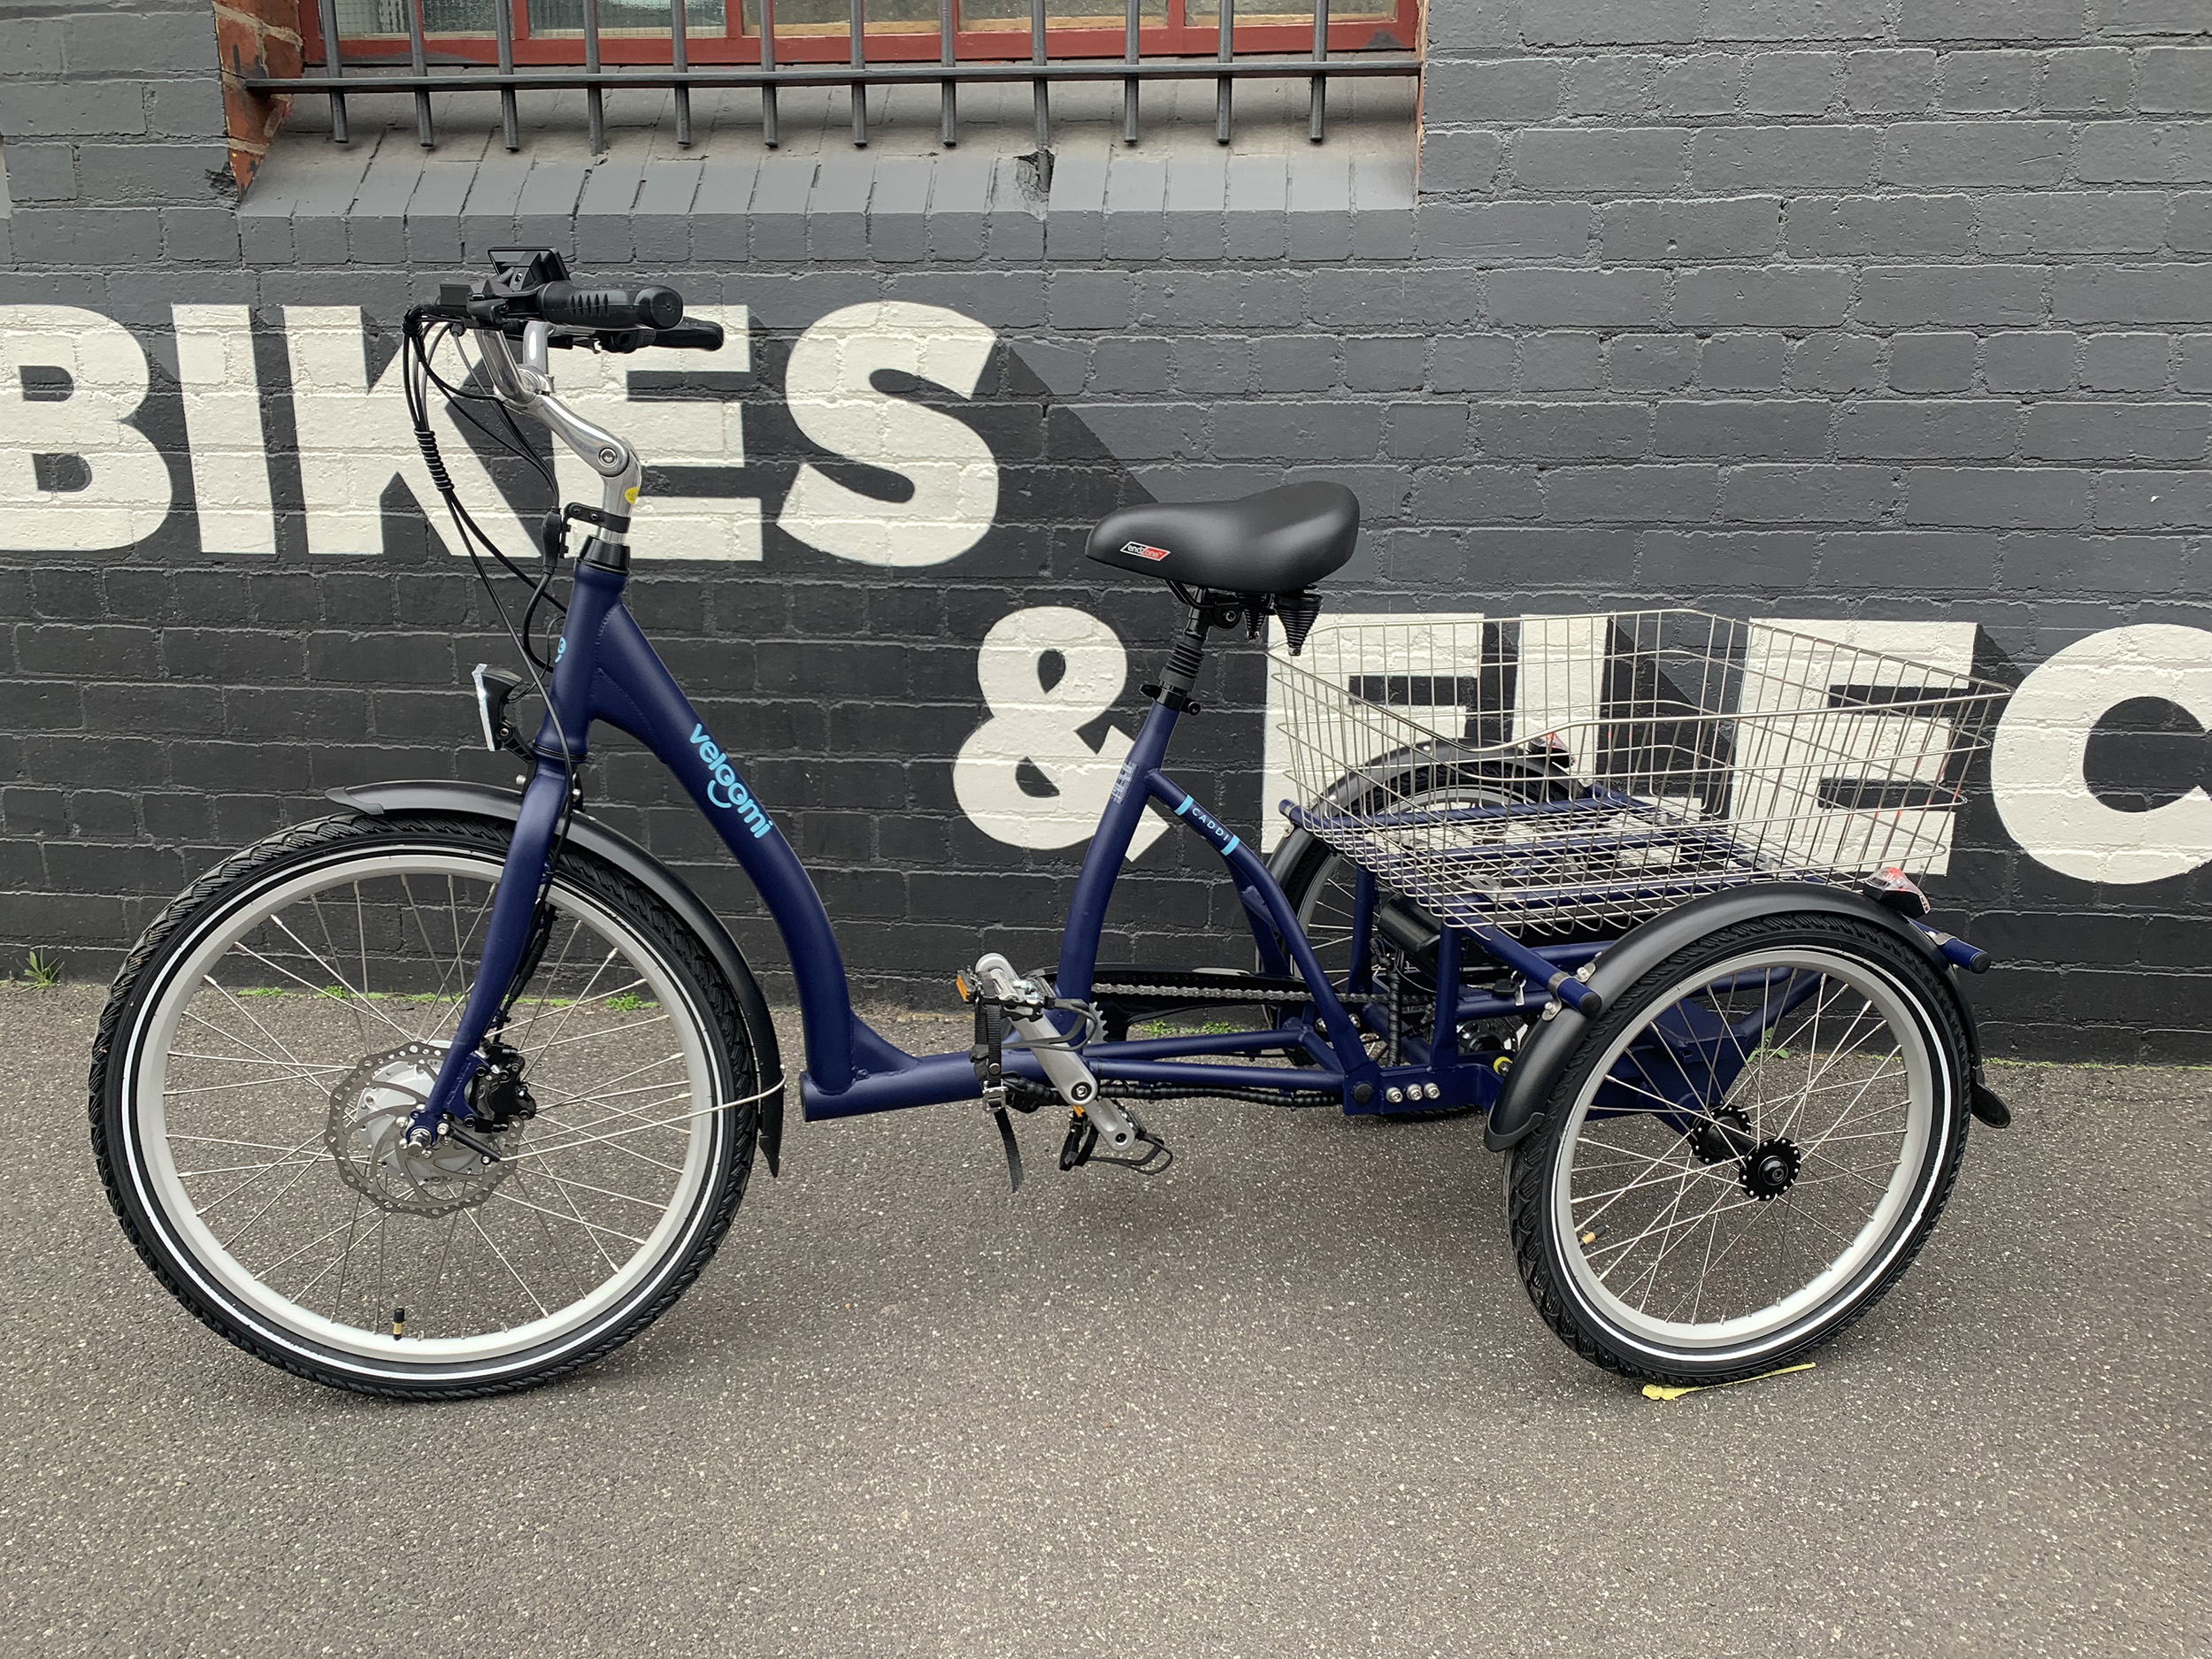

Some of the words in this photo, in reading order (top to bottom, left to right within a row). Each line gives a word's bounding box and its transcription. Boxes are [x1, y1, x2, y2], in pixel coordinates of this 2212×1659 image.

[0, 301, 999, 567] BIKES
[952, 606, 1171, 864] &
[1261, 613, 2212, 884] ELEC
[1191, 807, 1229, 841] CADDI
